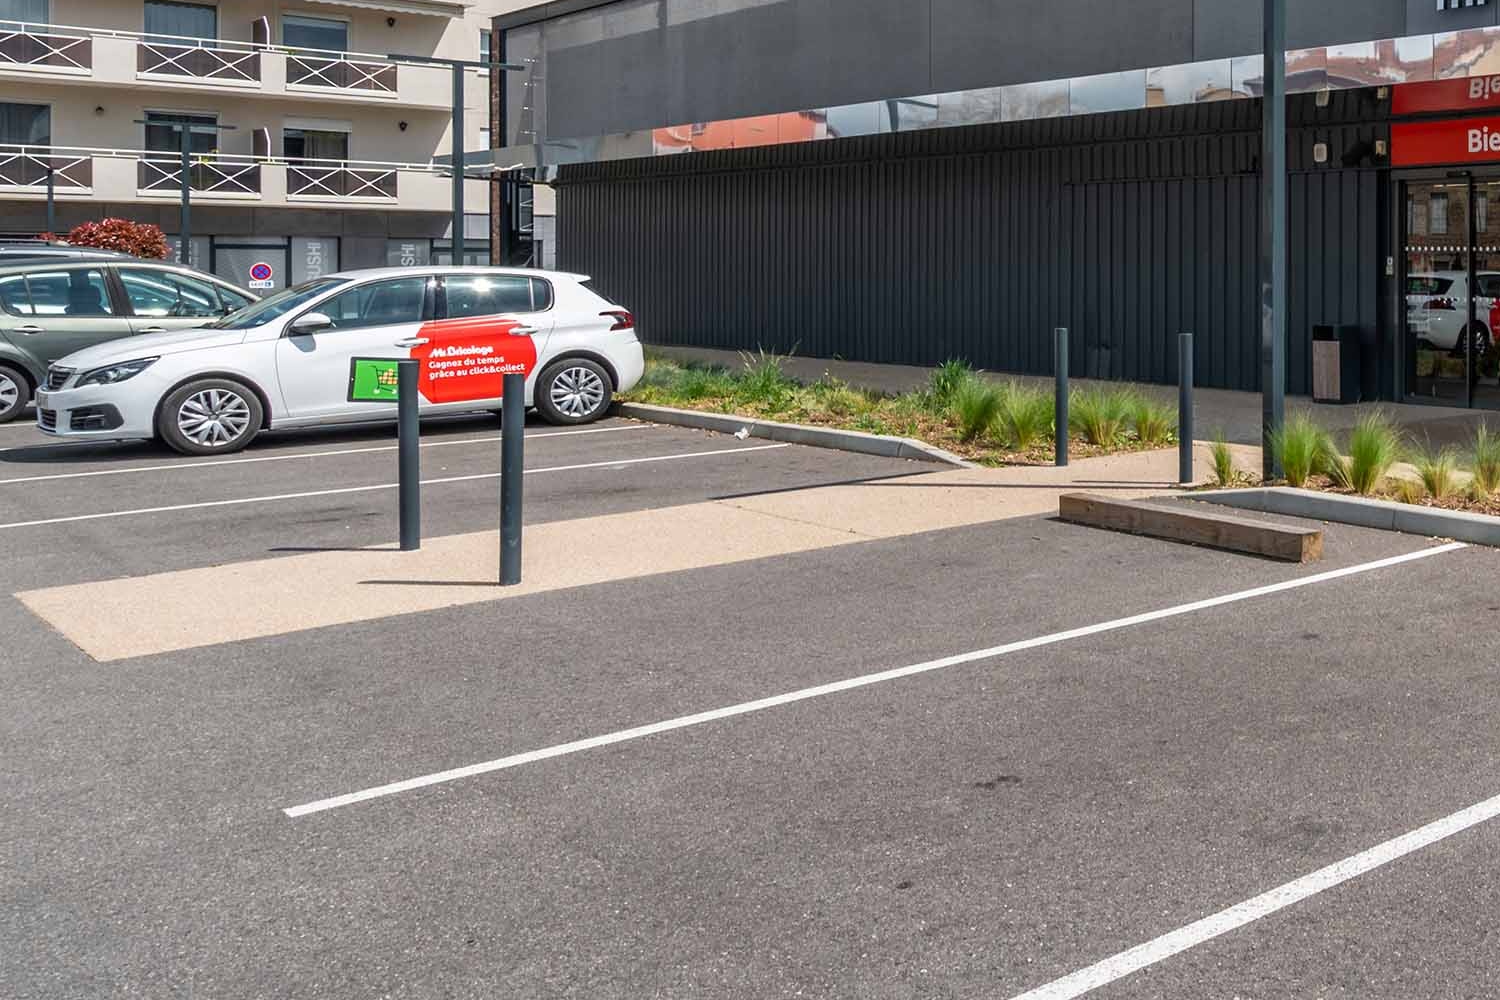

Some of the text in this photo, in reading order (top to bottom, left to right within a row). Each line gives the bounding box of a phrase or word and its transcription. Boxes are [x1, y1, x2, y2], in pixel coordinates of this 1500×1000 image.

[401, 244, 415, 266] SHI
[428, 356, 505, 370] Gagnez du temps
[429, 370, 455, 380] grâce
[469, 363, 525, 375] click&collect
